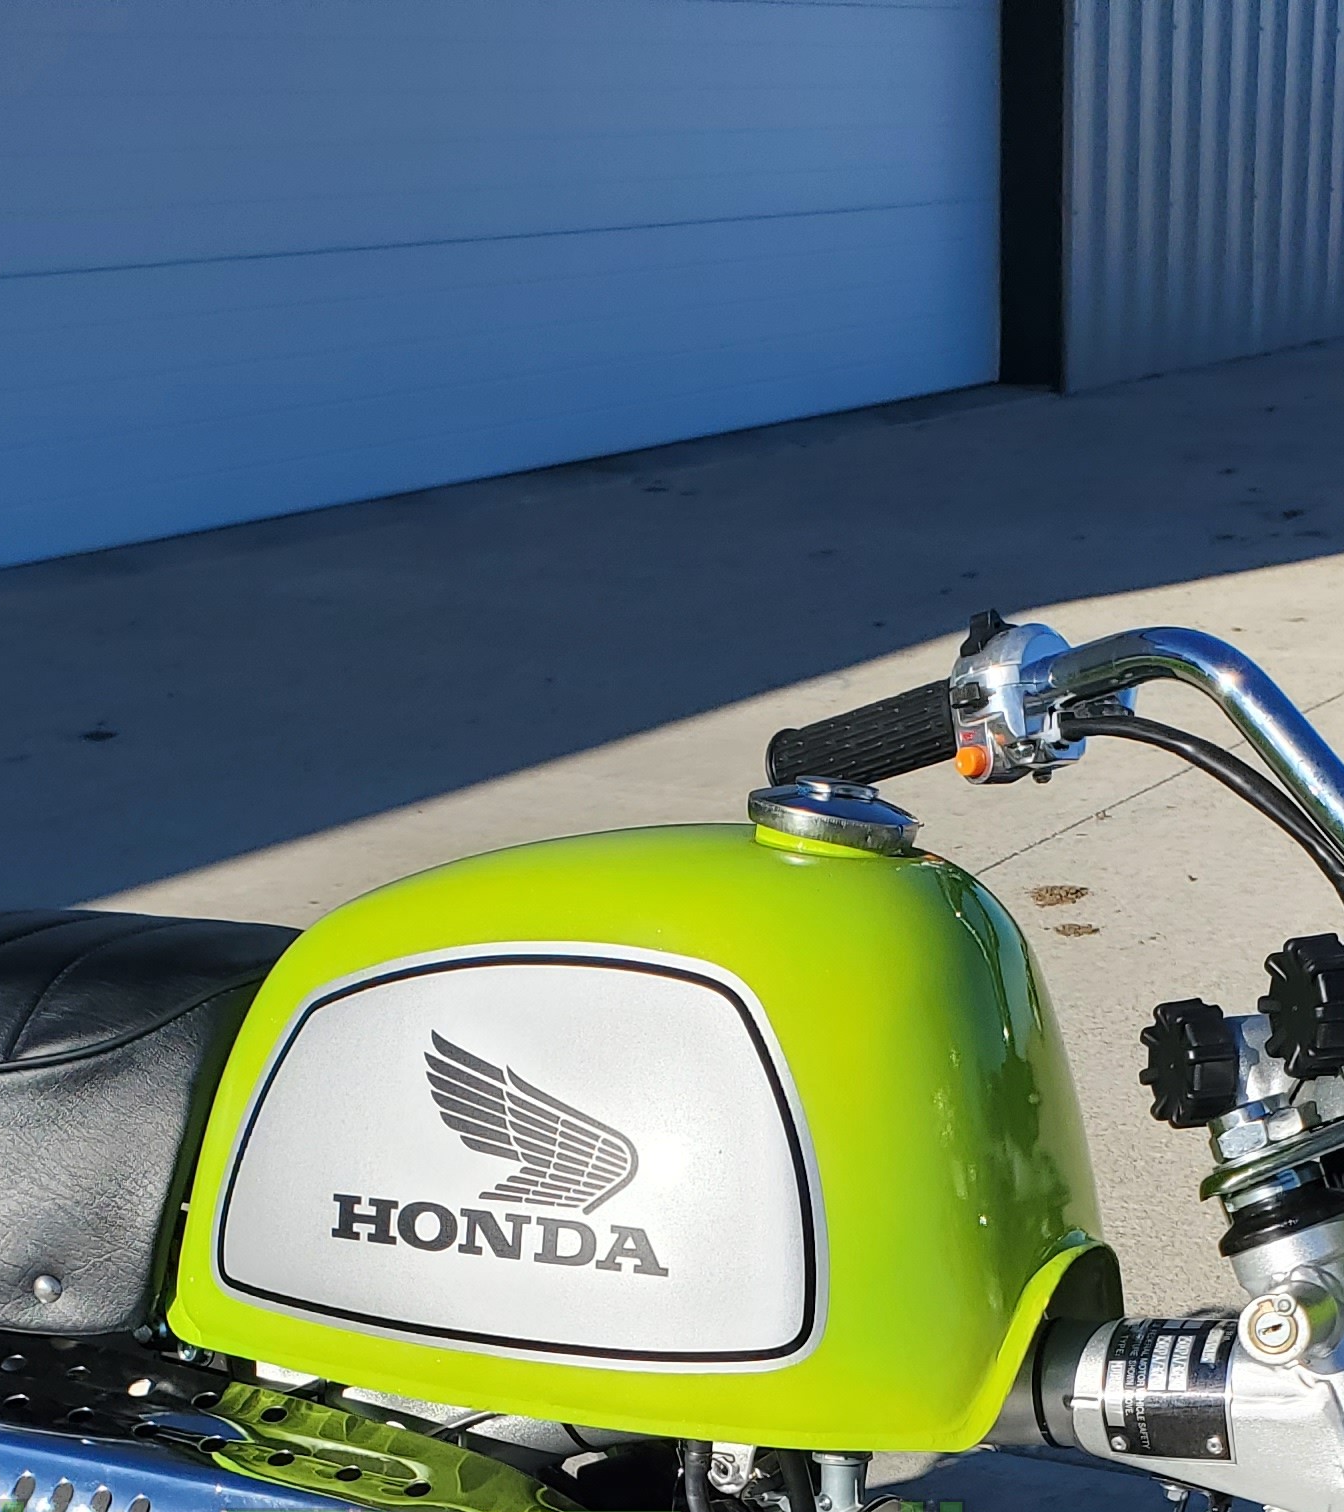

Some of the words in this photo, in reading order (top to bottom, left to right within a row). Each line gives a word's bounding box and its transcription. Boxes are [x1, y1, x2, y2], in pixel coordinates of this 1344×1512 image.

[331, 1194, 668, 1277] HONDA
[1136, 1358, 1149, 1387] MOTOR
[1137, 1422, 1151, 1449] SAFETY
